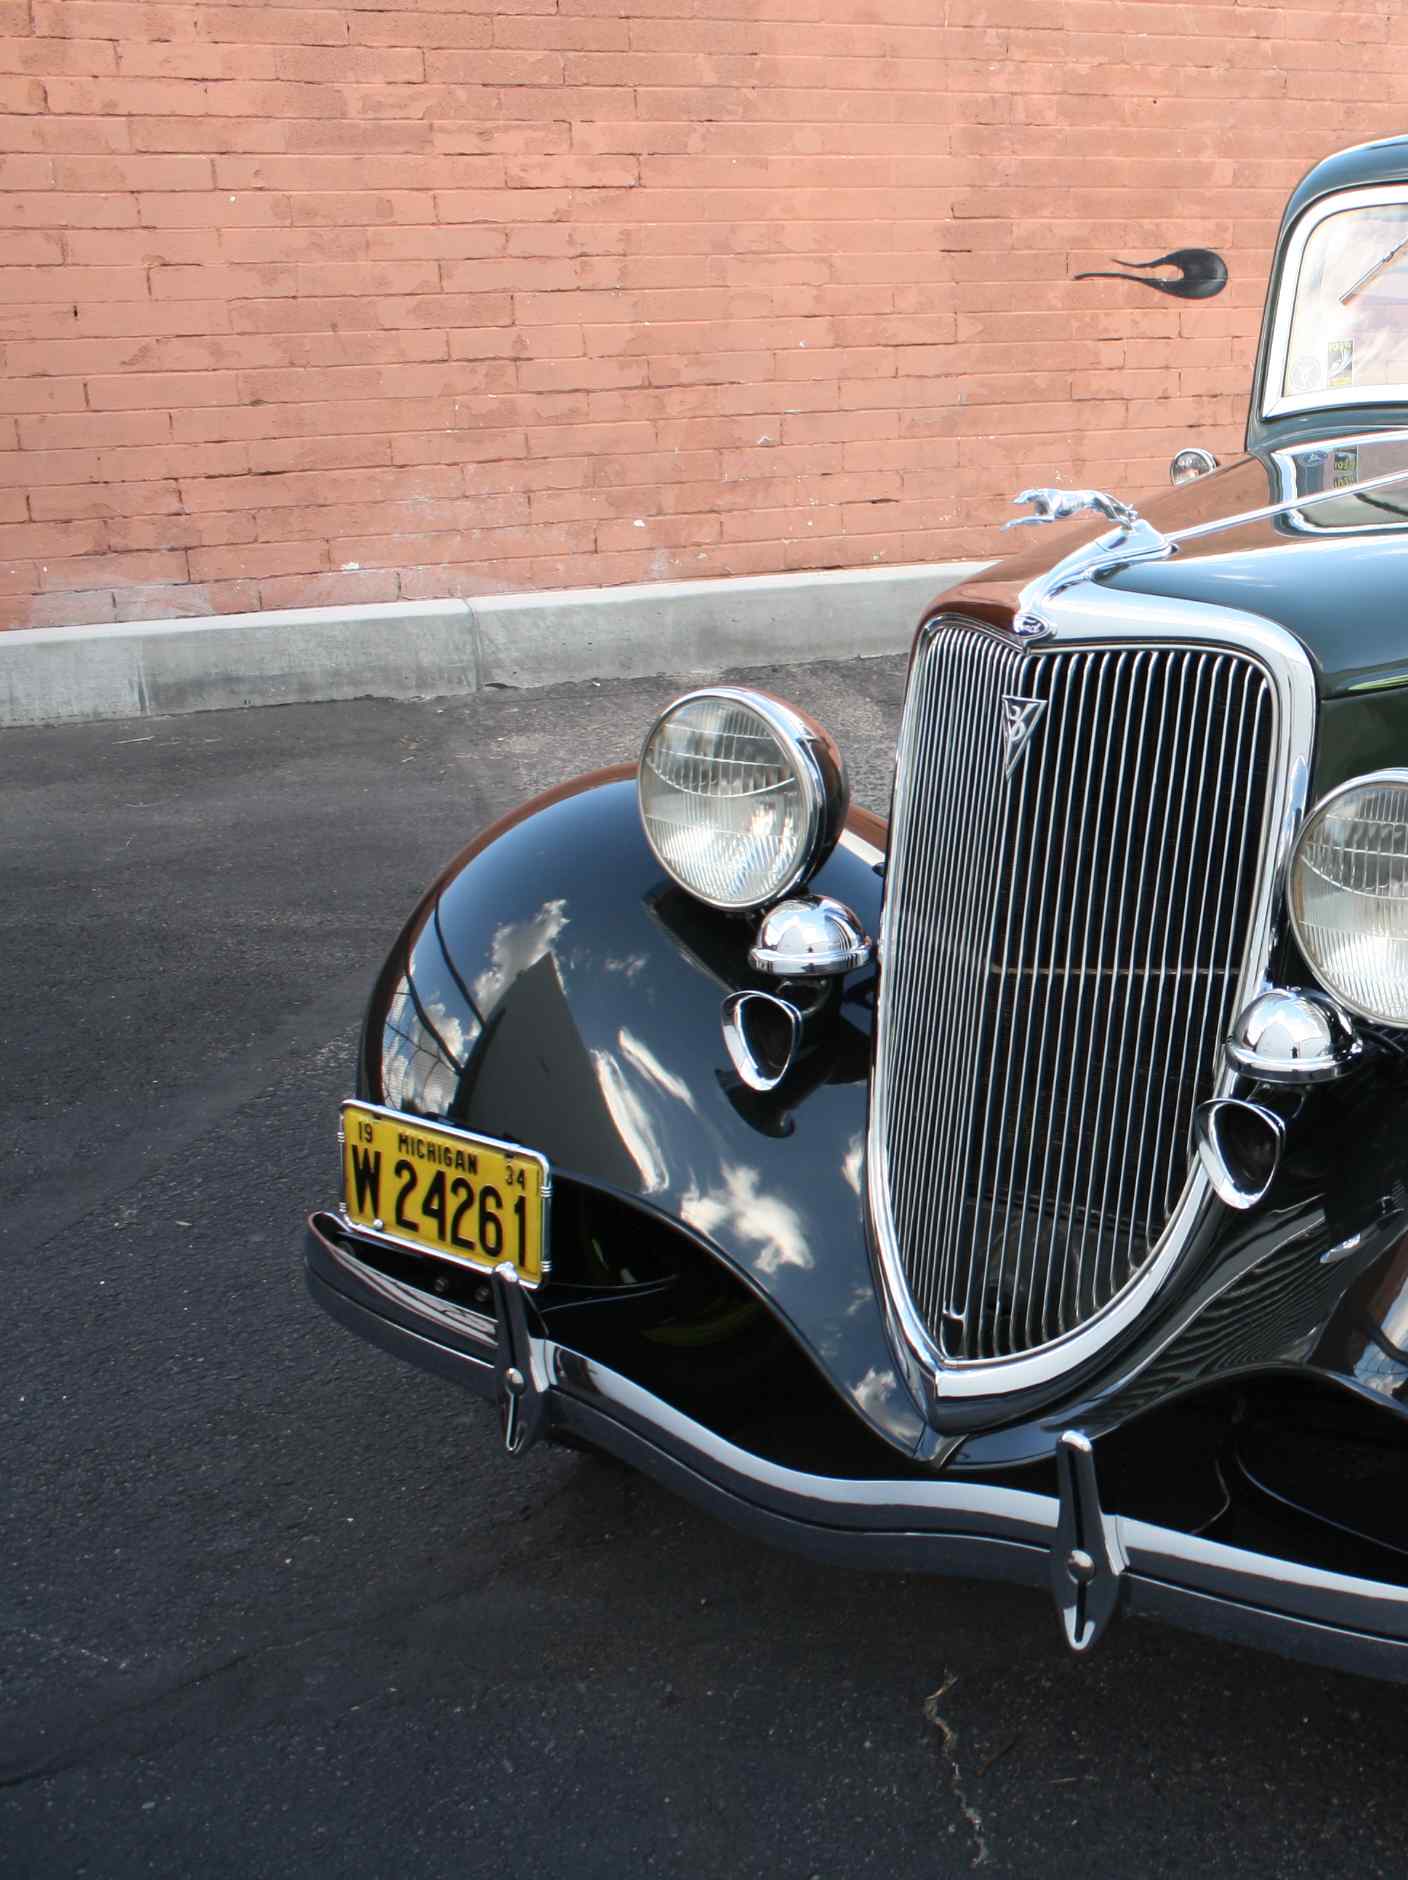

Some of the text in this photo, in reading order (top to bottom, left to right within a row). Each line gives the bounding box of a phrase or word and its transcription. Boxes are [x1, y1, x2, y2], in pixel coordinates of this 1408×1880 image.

[357, 1121, 526, 1190] 19 MICHIGAN 34
